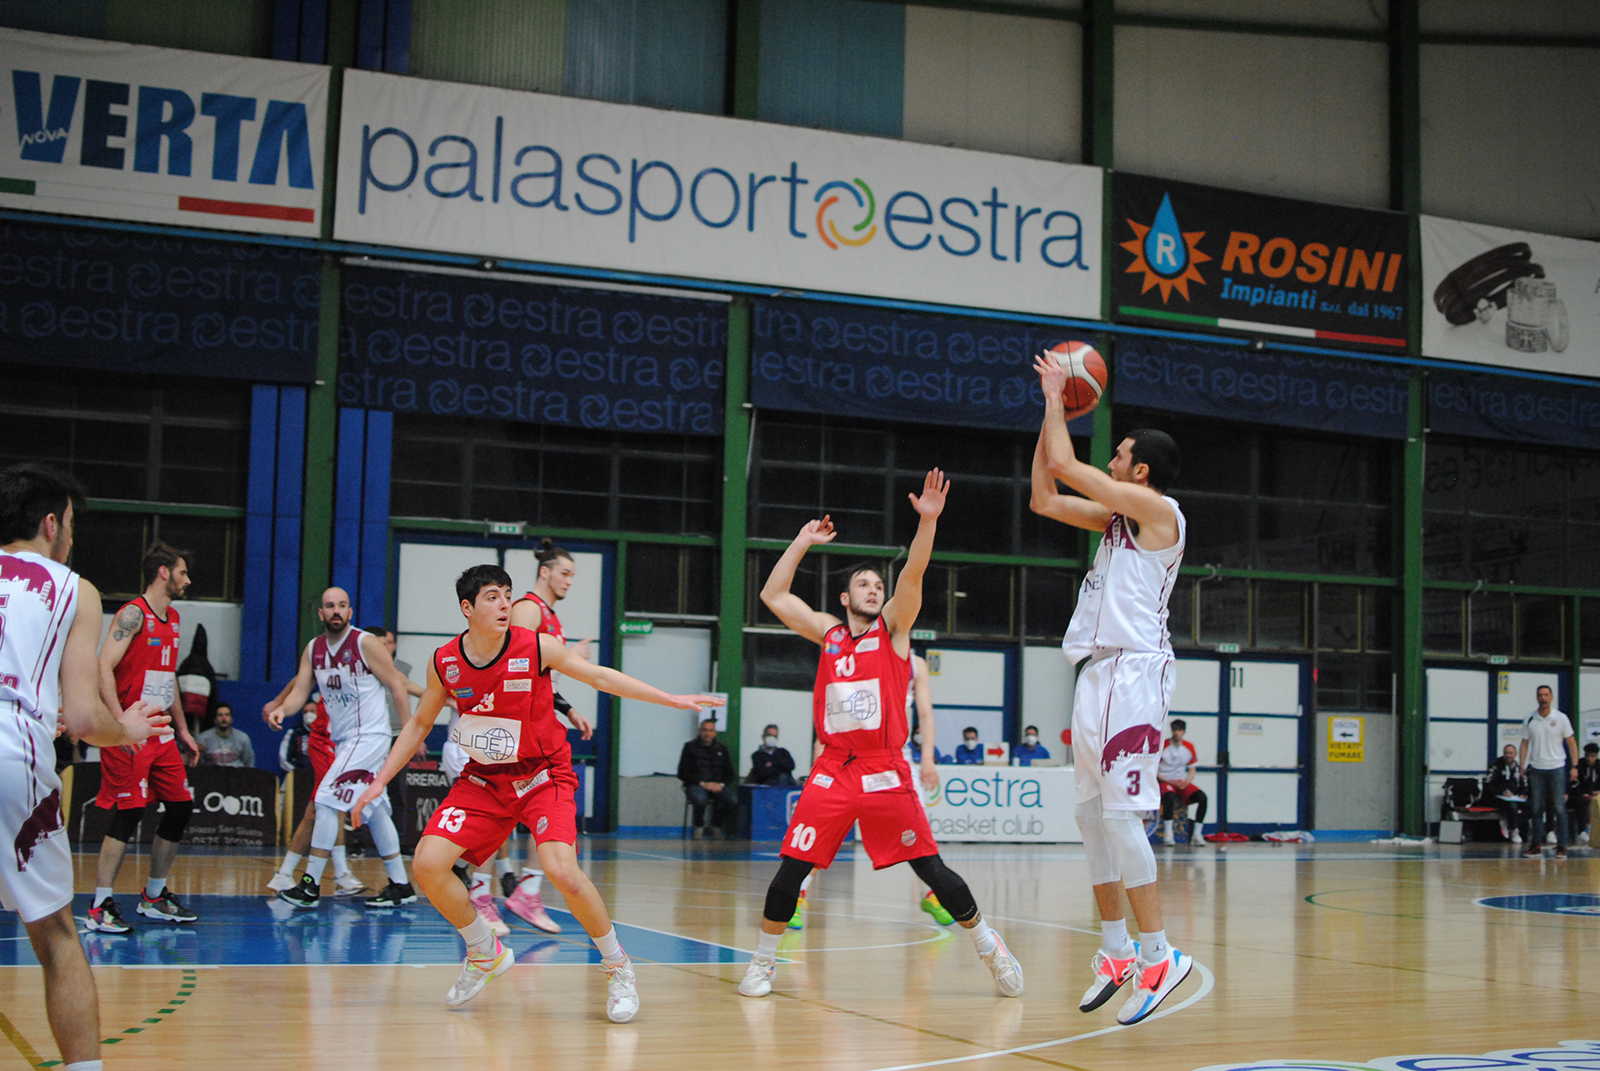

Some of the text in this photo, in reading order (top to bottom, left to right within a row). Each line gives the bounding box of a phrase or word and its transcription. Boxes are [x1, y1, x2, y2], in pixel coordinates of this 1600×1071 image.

[20, 127, 69, 147] NOVA
[358, 115, 1089, 270] palasport estra
[1155, 232, 1177, 267] R
[1221, 231, 1402, 293] ROSINI
[165, 262, 283, 304] estra
[1220, 277, 1317, 310] Impianti
[1348, 302, 1369, 317] dal
[1373, 303, 1403, 320] 1967
[59, 300, 181, 345] estra
[230, 311, 318, 351] estr
[344, 280, 727, 347] estra estra estr
[842, 320, 941, 361] estra
[403, 330, 513, 373] estra
[555, 347, 661, 388] estra
[759, 350, 857, 394] estra
[896, 368, 993, 405] estra
[1121, 351, 1208, 393] estra
[1239, 370, 1320, 406] estra
[1350, 382, 1409, 416] estr
[338, 368, 715, 434] stra estra estra
[834, 653, 856, 678] 10
[928, 654, 940, 673] 10
[1230, 666, 1244, 688] 11
[326, 674, 342, 690] 40
[333, 788, 354, 804] 40
[406, 772, 449, 788] RRERIA
[945, 772, 1044, 808] estra
[1126, 769, 1141, 796] 3
[438, 806, 467, 834] 13
[790, 822, 817, 851] 10
[928, 812, 1044, 836] basket club
